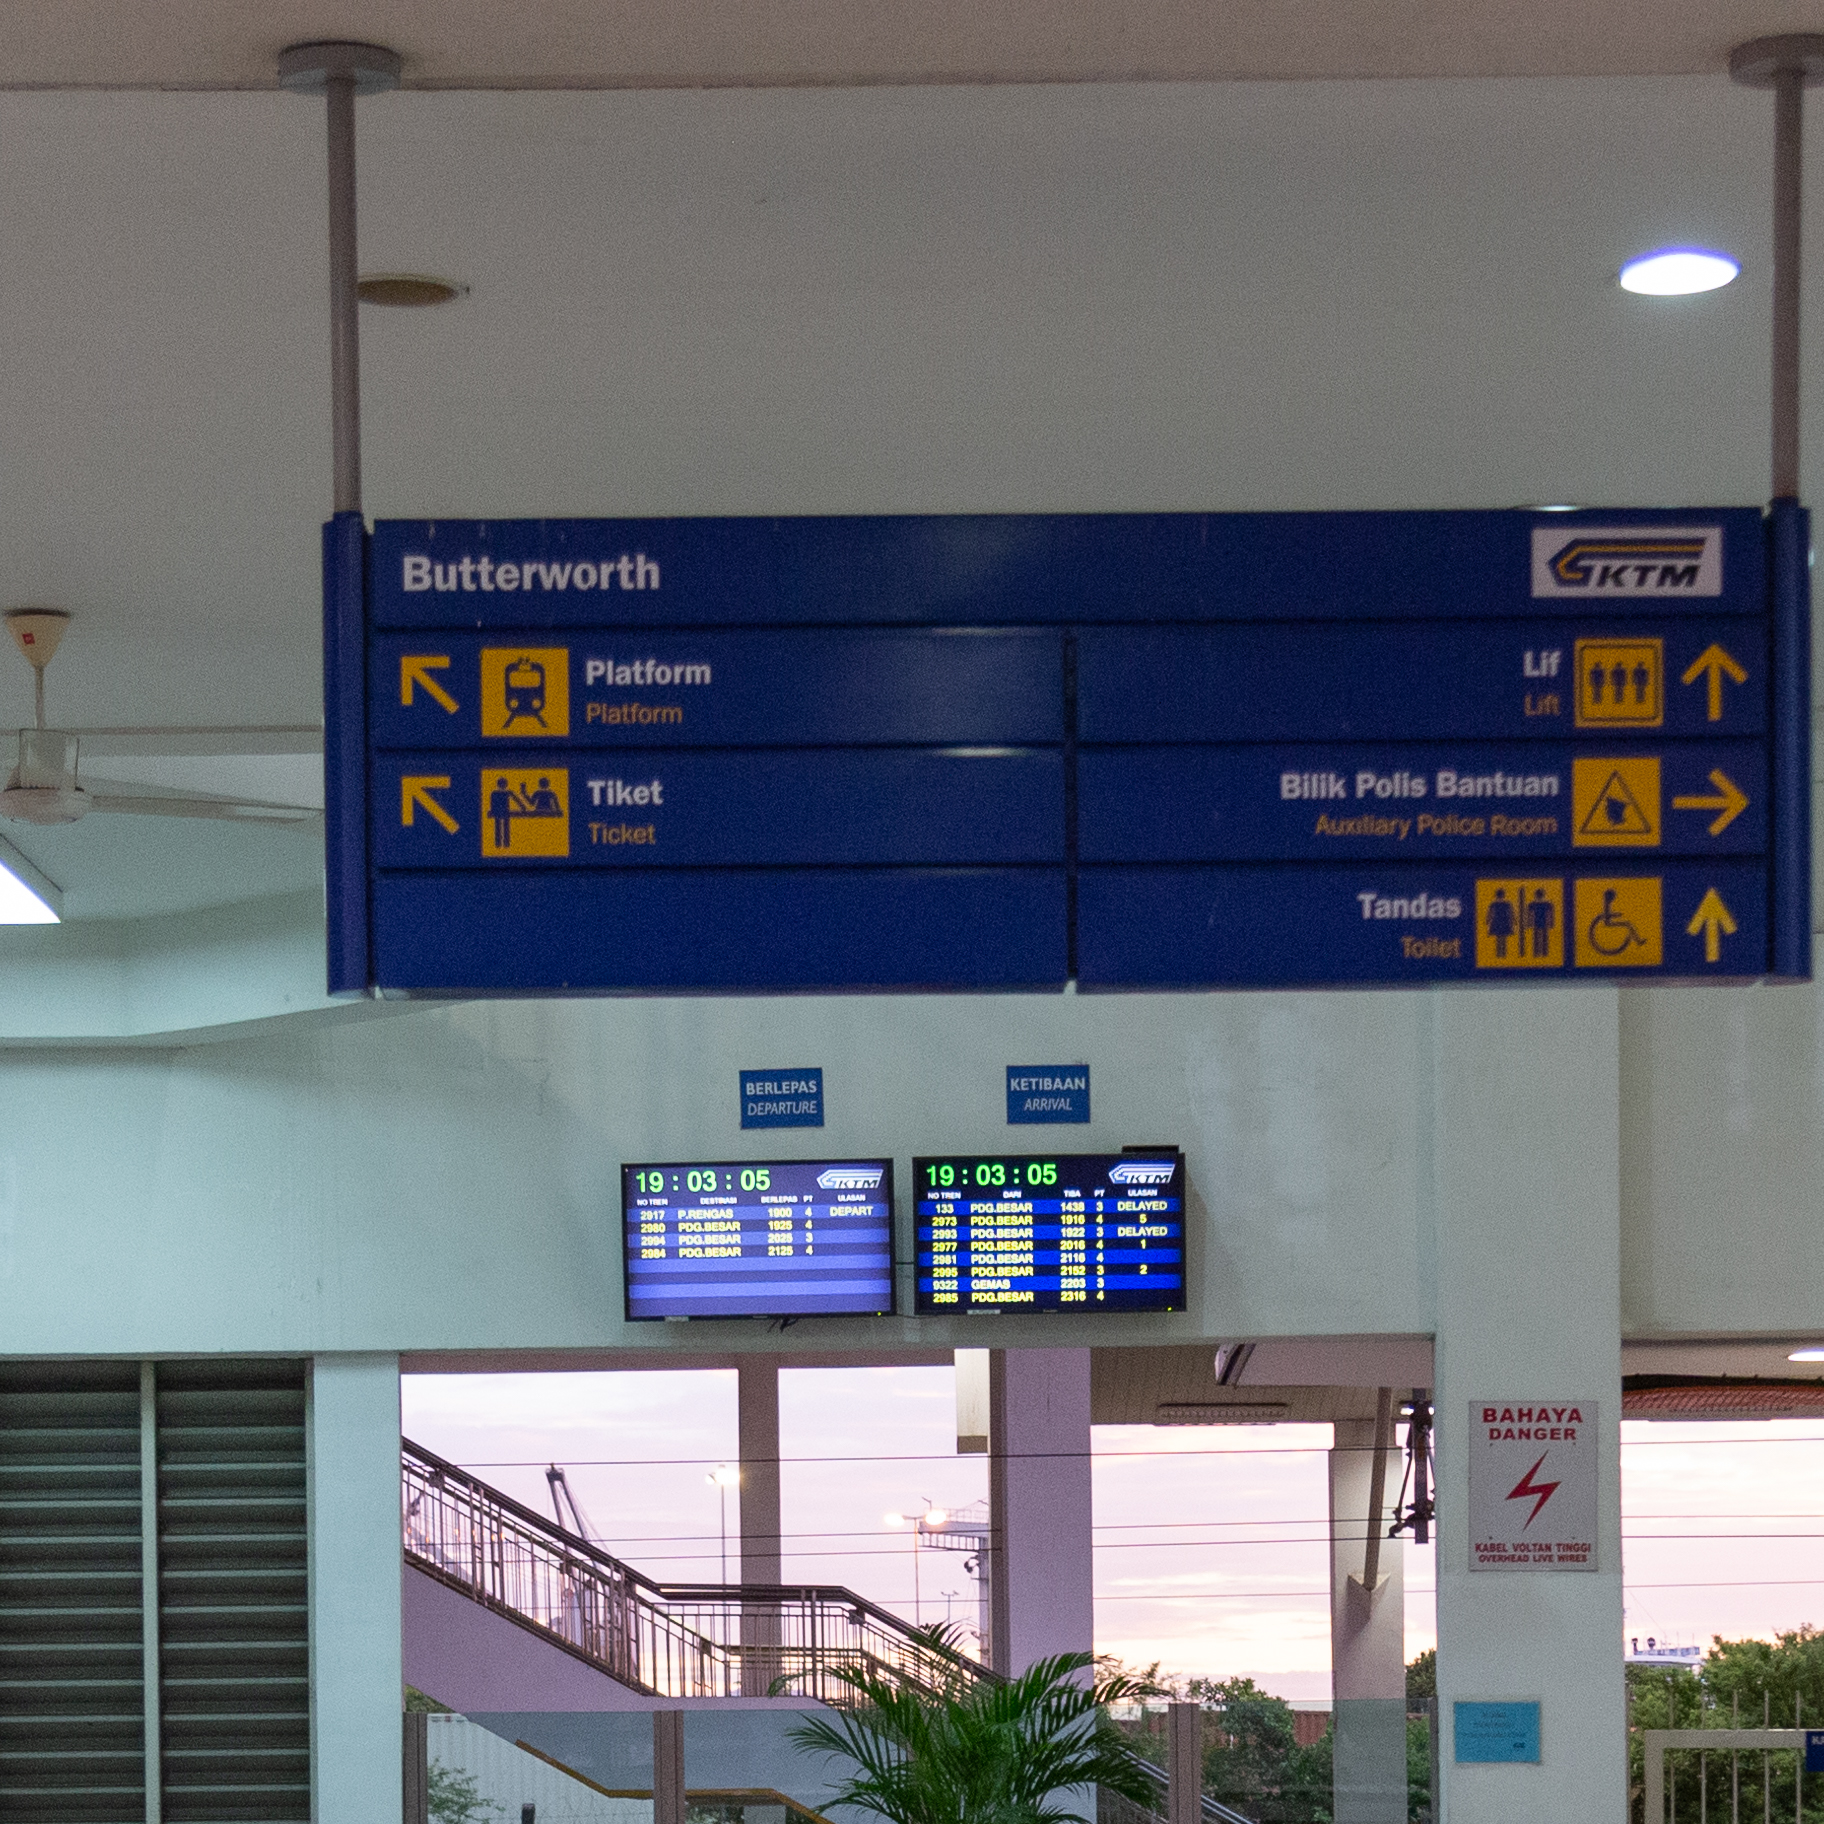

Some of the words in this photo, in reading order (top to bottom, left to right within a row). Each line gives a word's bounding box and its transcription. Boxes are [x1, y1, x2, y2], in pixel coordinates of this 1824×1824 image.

[402, 554, 661, 592] Butterworth
[1523, 650, 1562, 678] Lif
[585, 659, 712, 687] Platform
[1524, 694, 1561, 718] Lift
[586, 702, 683, 725] Platform
[1280, 772, 1347, 800] Bilik
[1355, 771, 1426, 799] Polis
[1435, 771, 1559, 798] Bantuan
[587, 780, 664, 807] Tiket
[588, 822, 656, 846] Ticket
[1315, 814, 1411, 841] Auxiliary
[1417, 814, 1485, 836] Police
[1490, 814, 1558, 836] Room
[1358, 893, 1462, 920] Tandas
[1401, 936, 1462, 960] Toilet
[746, 1080, 817, 1096] BERLEPAS
[1010, 1077, 1086, 1091] KETIBAAN
[747, 1101, 817, 1116] DEPARTURE
[1024, 1098, 1073, 1111] ARRIVAL
[1094, 1189, 1105, 1197] PT
[678, 1208, 734, 1219] P.RENGAS
[805, 1206, 813, 1217] 4
[829, 1206, 873, 1217] DEPART
[936, 1203, 954, 1214] 133
[970, 1203, 1034, 1214] PDG.BESAR
[1096, 1201, 1104, 1212] 3
[1117, 1201, 1168, 1211] DELAYED
[678, 1221, 741, 1232] PDG.BESAR
[805, 1219, 813, 1230] 4
[932, 1216, 957, 1227] 2973
[970, 1215, 1034, 1226] PDG.BESAR
[1096, 1213, 1104, 1224] 4
[1139, 1213, 1147, 1224] 5
[678, 1234, 741, 1245] PDG.BESAR
[805, 1232, 813, 1243] 3
[970, 1228, 1034, 1239] PDG.BESAR
[1060, 1227, 1086, 1238] 1922
[1096, 1226, 1104, 1237] 3
[1117, 1226, 1168, 1237] DELAYED
[678, 1246, 742, 1258] PDG.BESAR
[805, 1245, 813, 1256] 4
[932, 1242, 957, 1253] 2977
[970, 1241, 1034, 1252] PDG.BESAR
[1096, 1239, 1104, 1250] 4
[1140, 1239, 1146, 1249] 1
[970, 1254, 1034, 1265] PDG.BESAR
[1096, 1252, 1104, 1263] 4
[970, 1266, 1034, 1277] PDG.BESAR
[1096, 1264, 1104, 1275] 3
[1139, 1264, 1148, 1275] 2
[971, 1279, 1011, 1290] GEMAS
[1096, 1277, 1104, 1288] 3
[970, 1292, 1034, 1303] PDG.BESAR
[1096, 1290, 1104, 1301] 4
[1482, 1407, 1583, 1423] BAHAYA
[1488, 1427, 1576, 1441] DANGER
[1475, 1543, 1508, 1552] KABEL
[1512, 1543, 1552, 1552] VOLTAN
[1556, 1543, 1591, 1552] TINGGI
[1478, 1554, 1529, 1563] OVERHEAD
[1533, 1554, 1554, 1563] LIVE
[1557, 1554, 1588, 1563] WIRES
